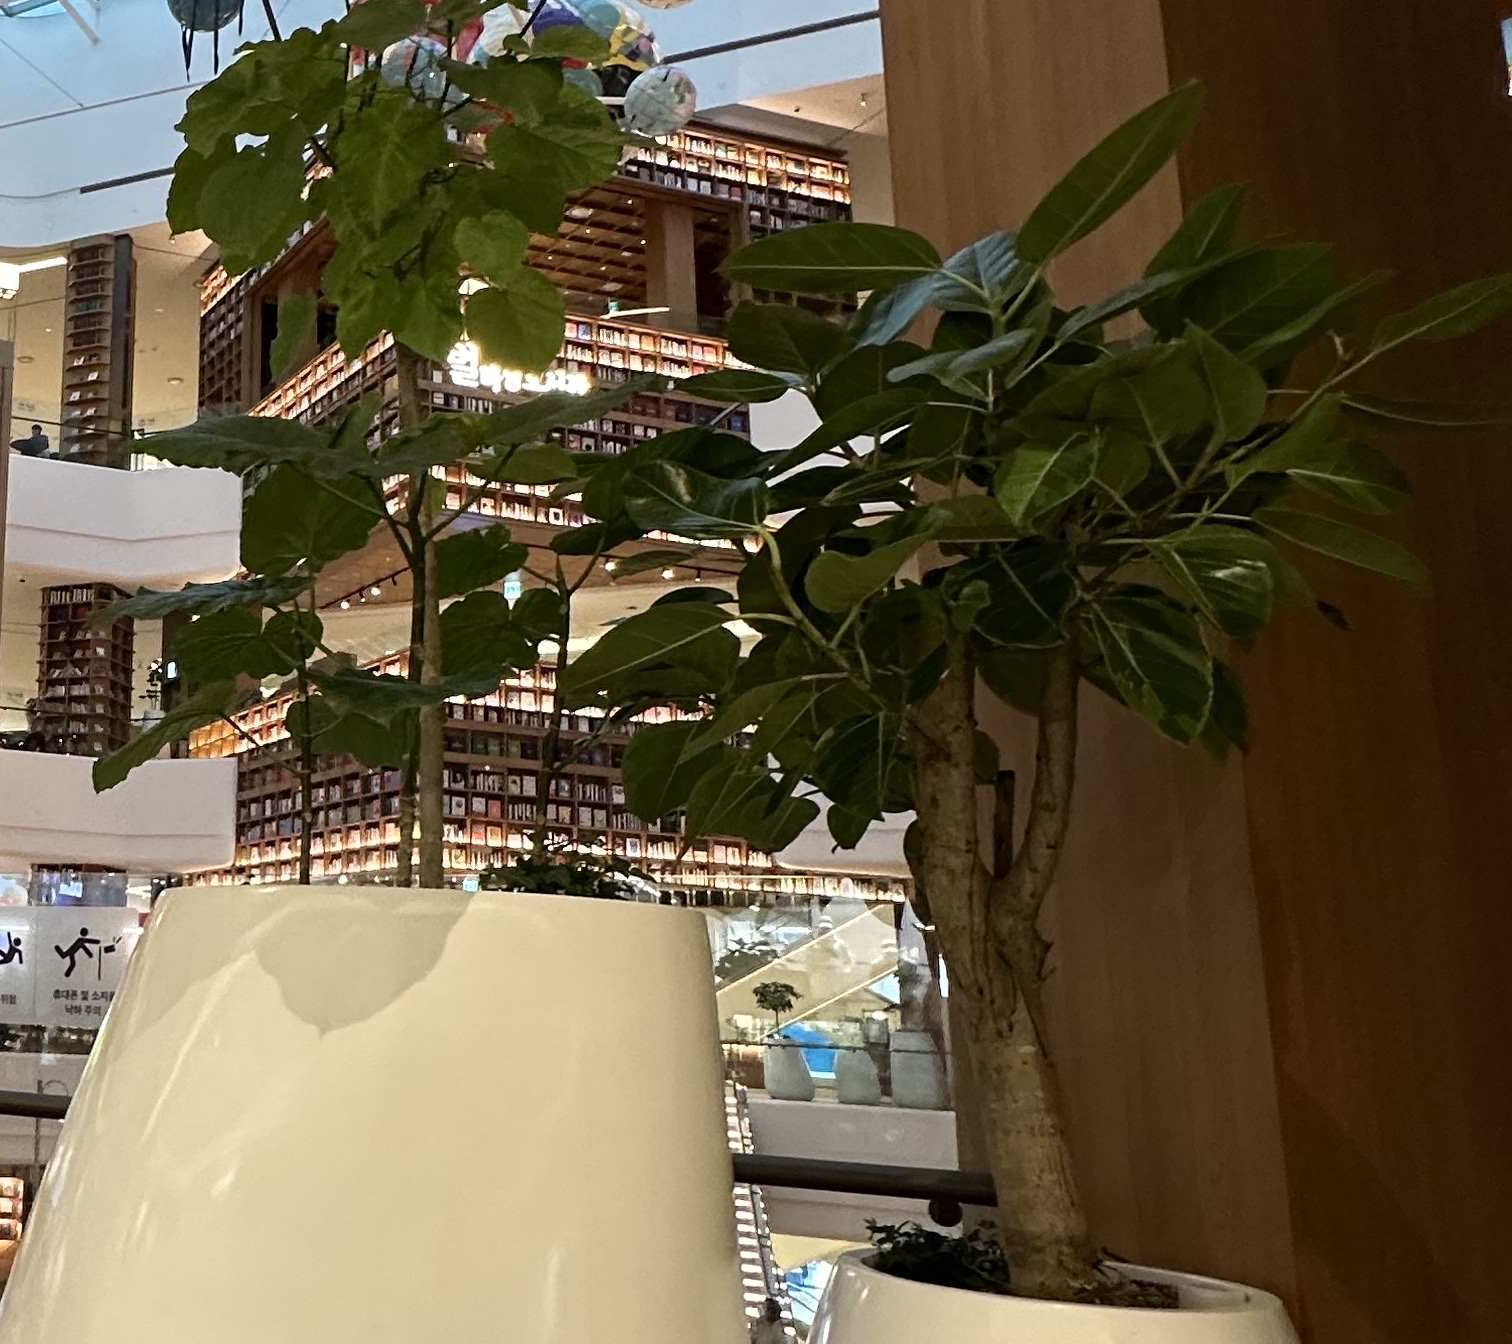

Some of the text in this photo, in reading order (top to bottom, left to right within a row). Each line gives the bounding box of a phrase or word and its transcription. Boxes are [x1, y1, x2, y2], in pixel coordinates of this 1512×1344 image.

[0, 994, 17, 1005] 위험
[53, 989, 78, 1001] 휴대폰
[81, 989, 89, 1002] 및
